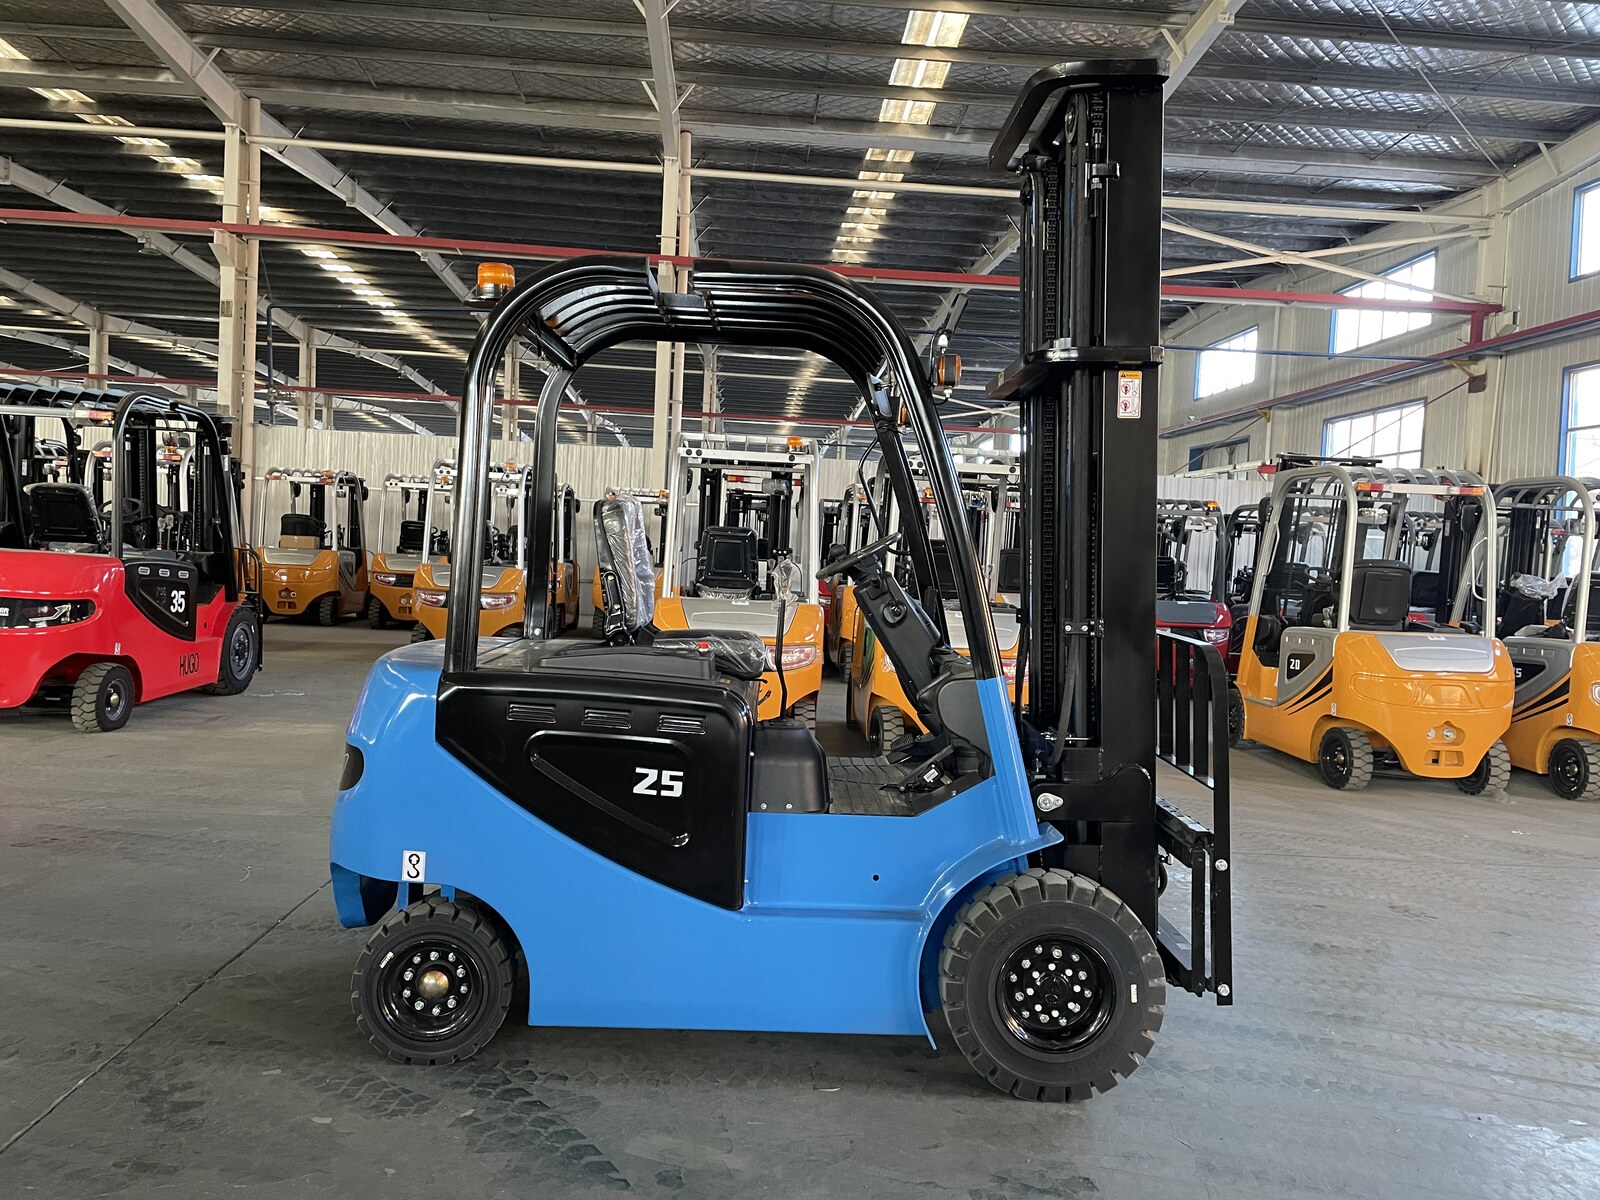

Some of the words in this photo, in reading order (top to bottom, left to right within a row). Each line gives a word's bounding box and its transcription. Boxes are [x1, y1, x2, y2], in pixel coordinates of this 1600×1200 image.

[170, 590, 186, 613] 35
[179, 653, 199, 677] HUGO
[1290, 659, 1300, 670] 20
[1513, 667, 1522, 678] 5
[633, 767, 684, 797] 25
